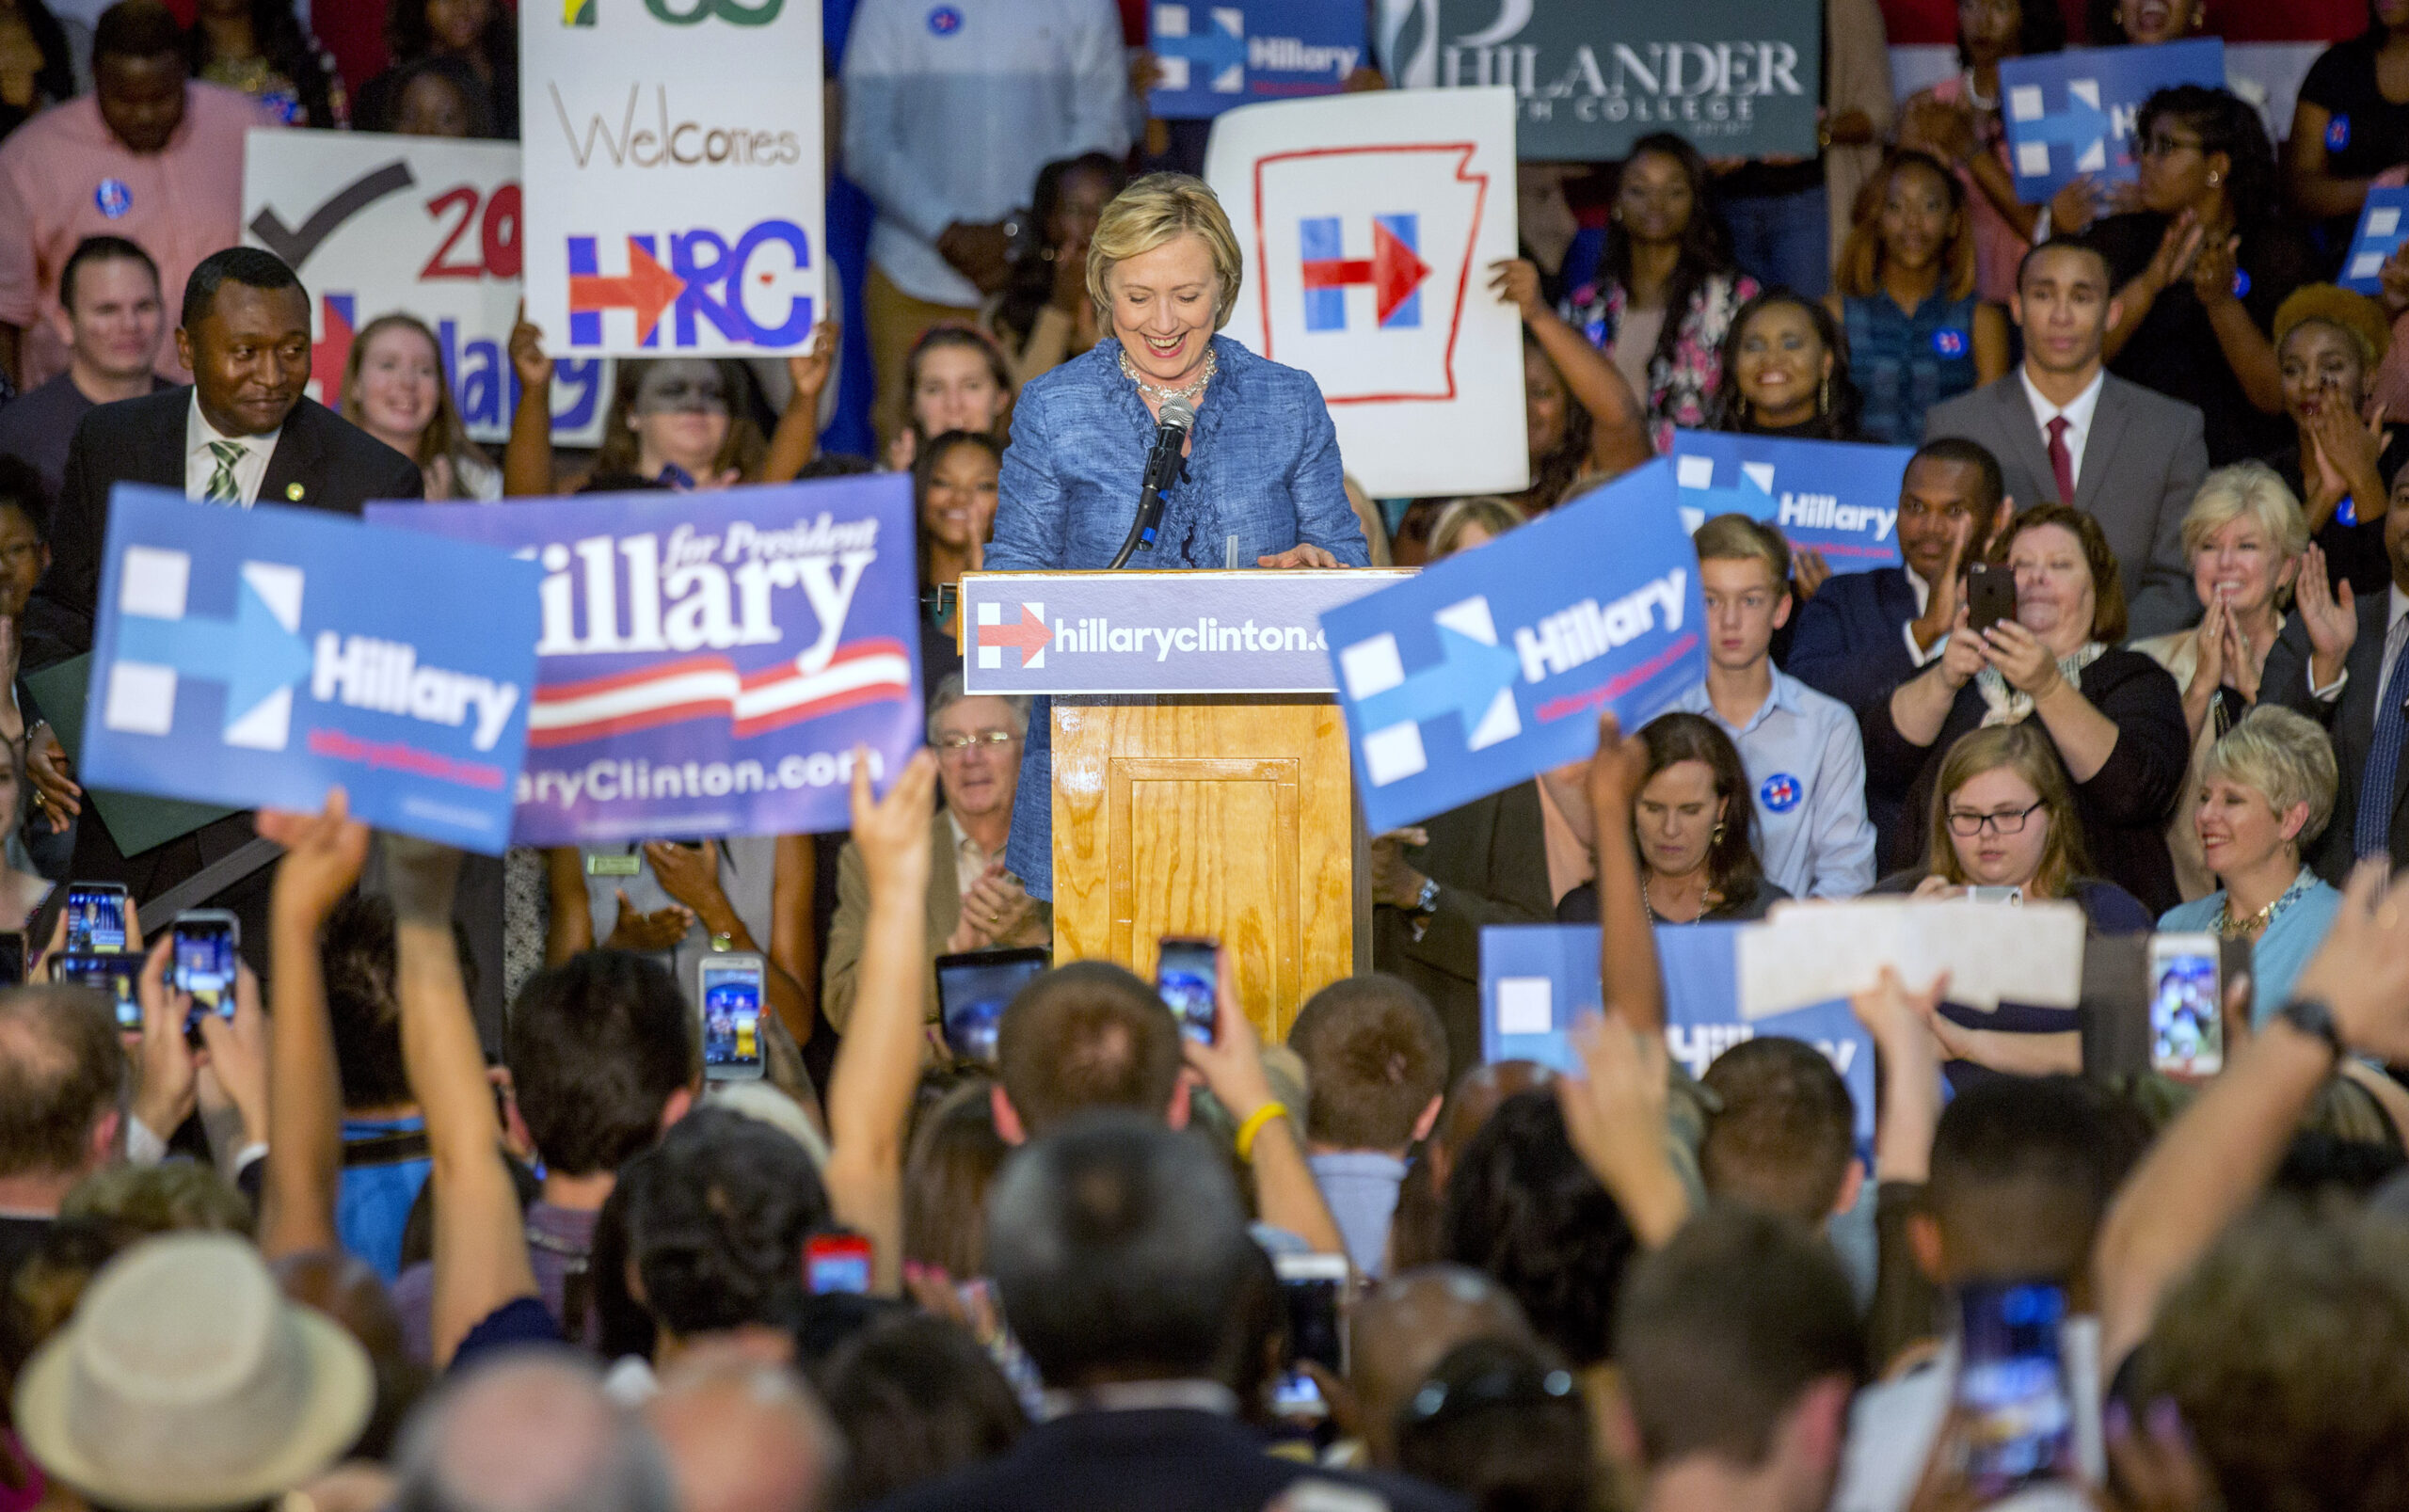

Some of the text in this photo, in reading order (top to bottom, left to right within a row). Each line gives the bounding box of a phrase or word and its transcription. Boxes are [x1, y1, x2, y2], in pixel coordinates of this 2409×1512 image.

[1248, 37, 1361, 81] Hillary
[546, 80, 802, 168] Welcomes
[1572, 95, 1756, 123] COLLEGE
[419, 183, 523, 280] 20
[567, 221, 814, 348] HRC
[661, 511, 880, 578] for President
[1778, 492, 1897, 542] Hillary
[511, 533, 878, 676] illary
[1513, 566, 1687, 685] Hillary
[311, 629, 520, 751] Hillary
[515, 749, 884, 811] aryClinton.com
